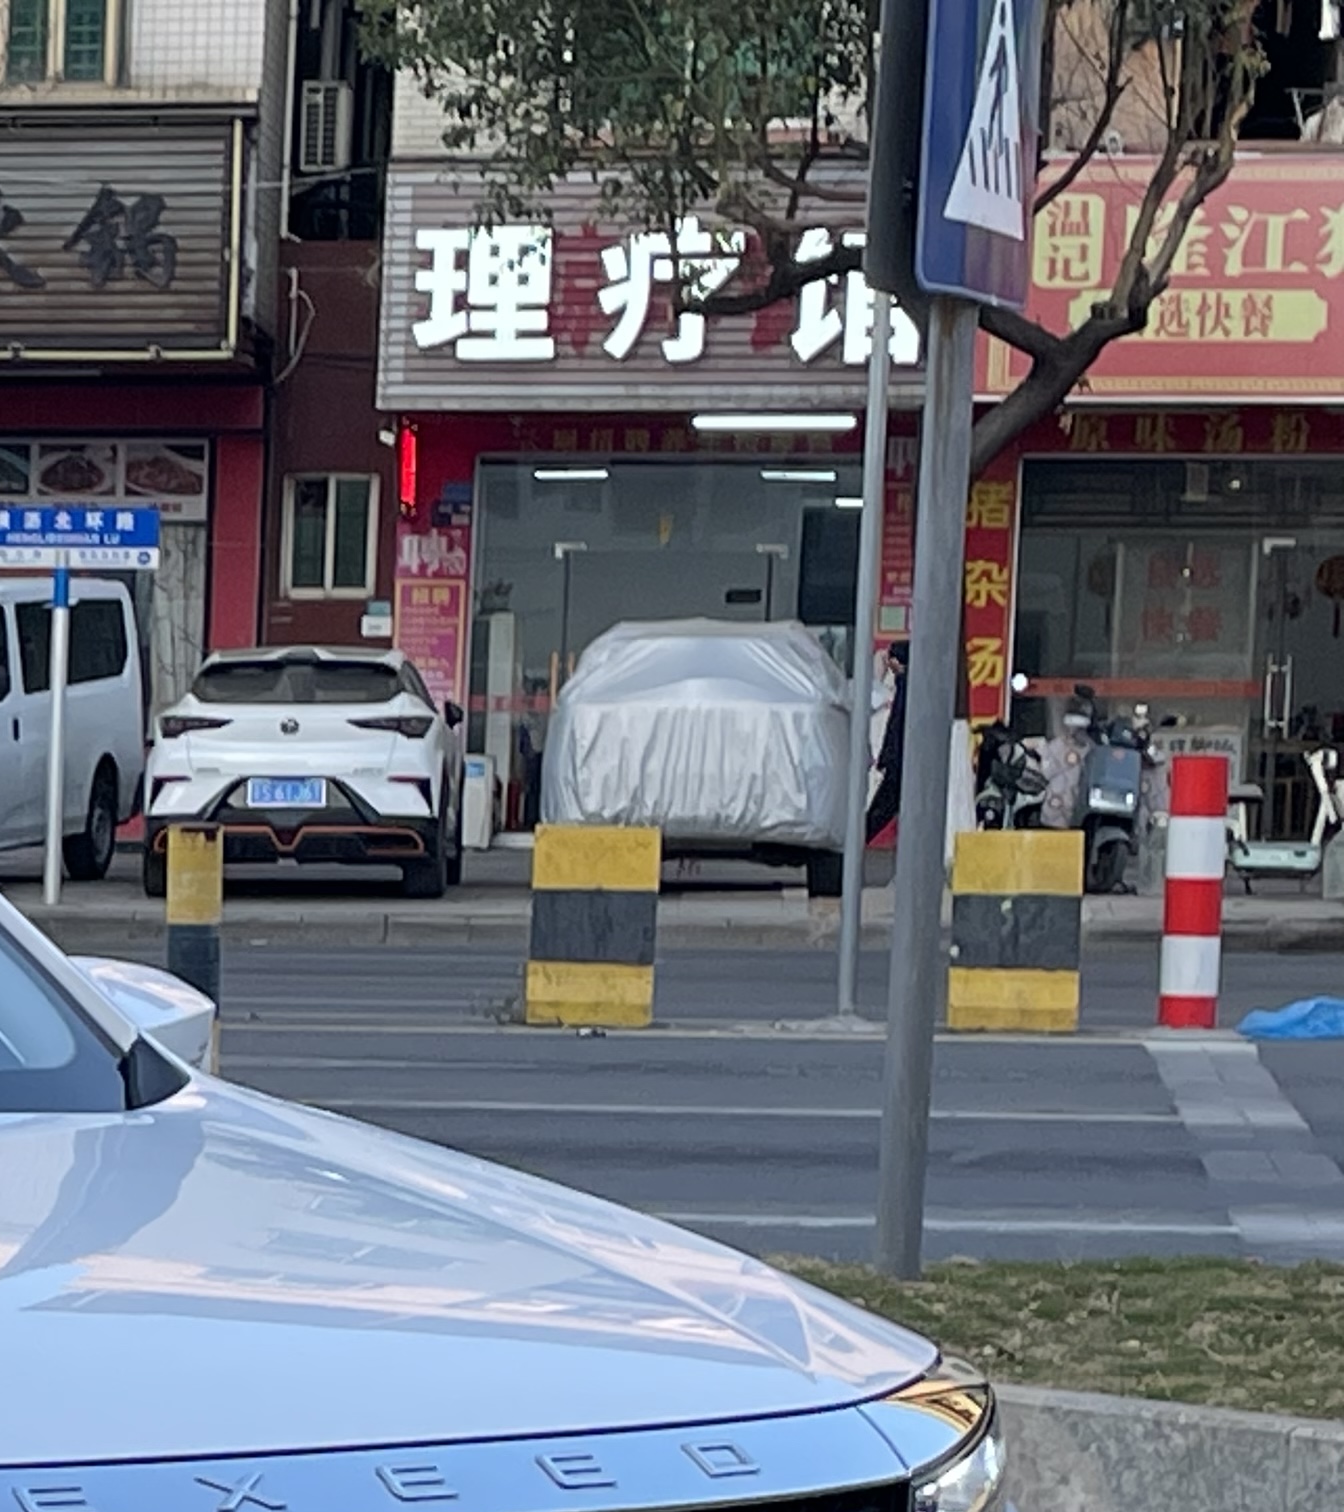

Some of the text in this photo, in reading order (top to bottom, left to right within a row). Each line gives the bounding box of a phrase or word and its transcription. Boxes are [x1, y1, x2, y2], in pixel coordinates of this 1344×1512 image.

[1046, 199, 1091, 284] 温记
[1138, 293, 1274, 338] 选快餐
[965, 480, 1012, 762] 猪杂汤
